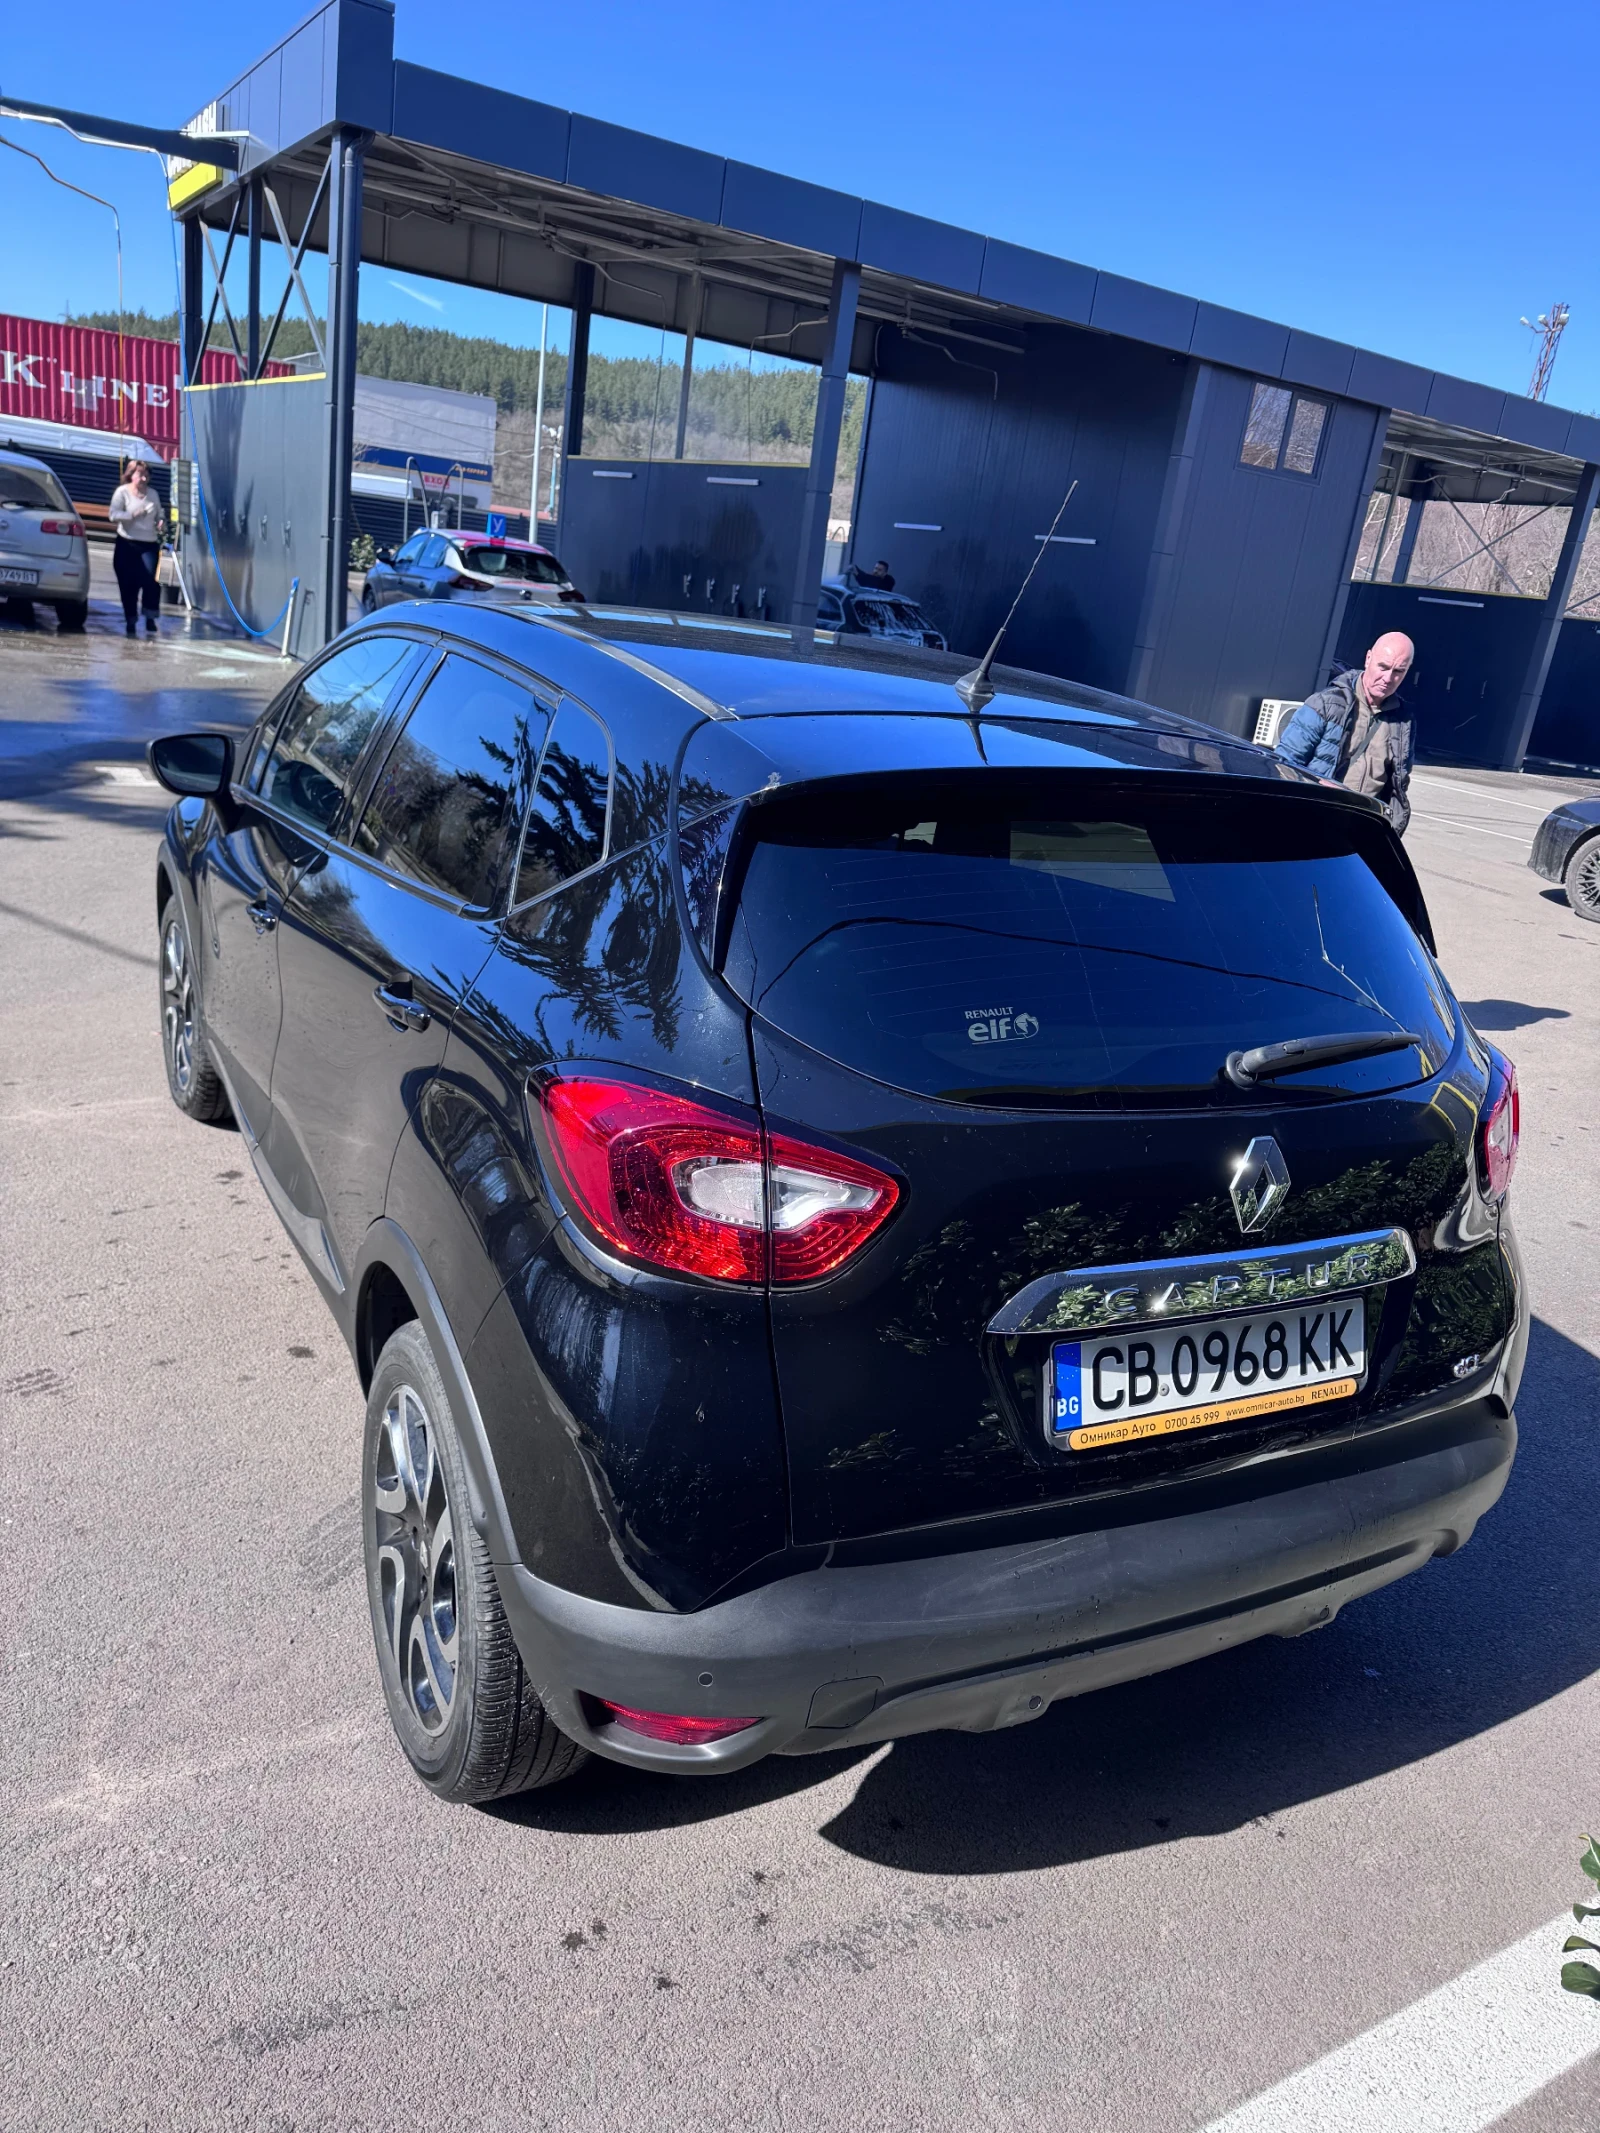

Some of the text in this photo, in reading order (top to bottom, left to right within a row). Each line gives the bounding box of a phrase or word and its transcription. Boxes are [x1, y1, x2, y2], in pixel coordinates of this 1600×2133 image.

[61, 370, 170, 408] LINE
[964, 1006, 1013, 1019] RENAULT
[968, 1017, 1011, 1042] elf
[1104, 1254, 1371, 1314] CAPTUR
[1091, 1308, 1355, 1411] CB 0968 KK
[1057, 1395, 1079, 1418] BG
[1080, 1384, 1349, 1444] Омникар Ауто 0700 45 999 www.omnicar-auto.bg RENAULT
